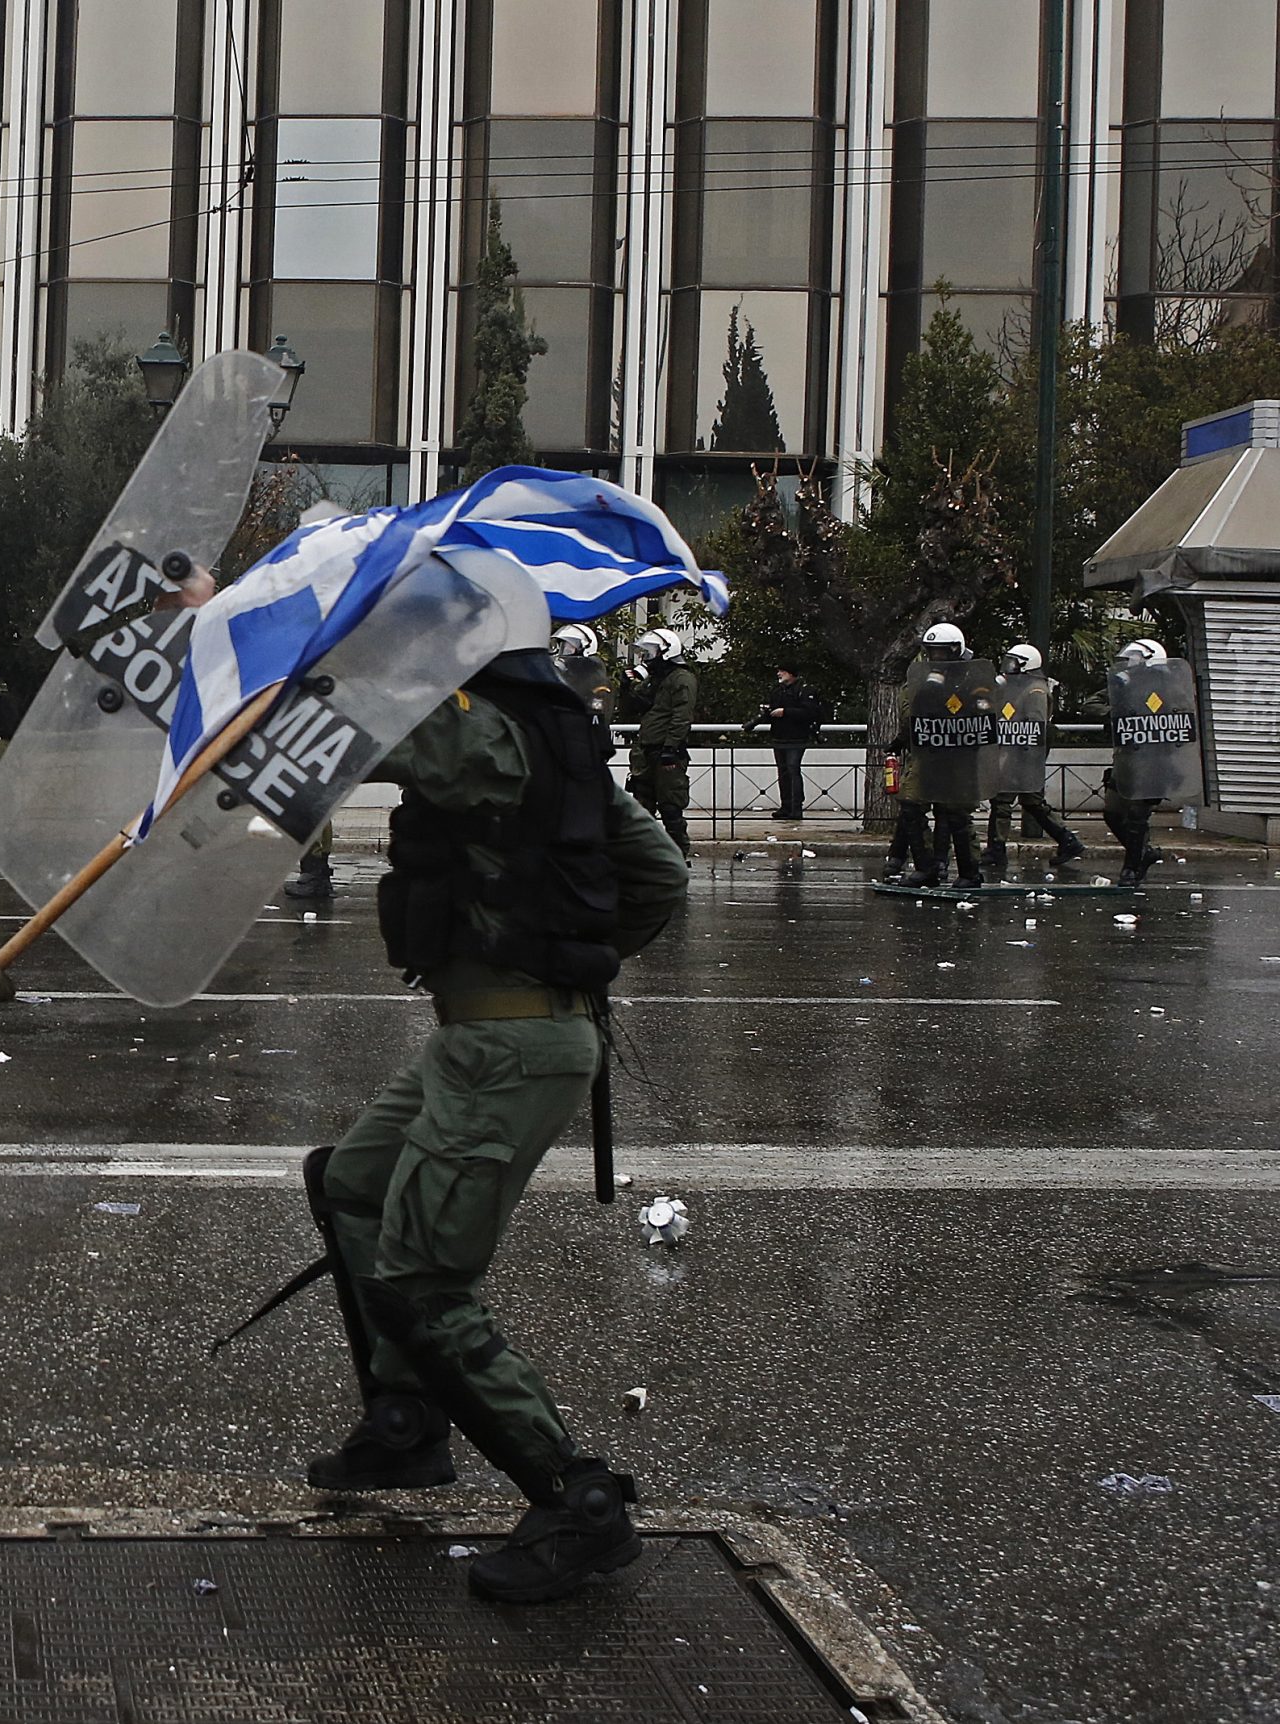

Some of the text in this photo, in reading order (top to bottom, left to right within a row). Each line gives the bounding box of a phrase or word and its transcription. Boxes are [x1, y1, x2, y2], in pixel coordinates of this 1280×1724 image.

[84, 549, 357, 785] ΑΣΤΜΙΑ
[60, 608, 310, 817] POCE
[913, 715, 992, 734] ΑΣΤΥΝΟΜΙΑ
[998, 721, 1041, 735] ΥΝΟΜΙΑ
[1116, 714, 1192, 733] ΑΣΤΥΝΟΜΙΑ
[918, 731, 989, 747] POLICE
[998, 734, 1038, 746] LICE
[1121, 729, 1190, 745] POLICE
